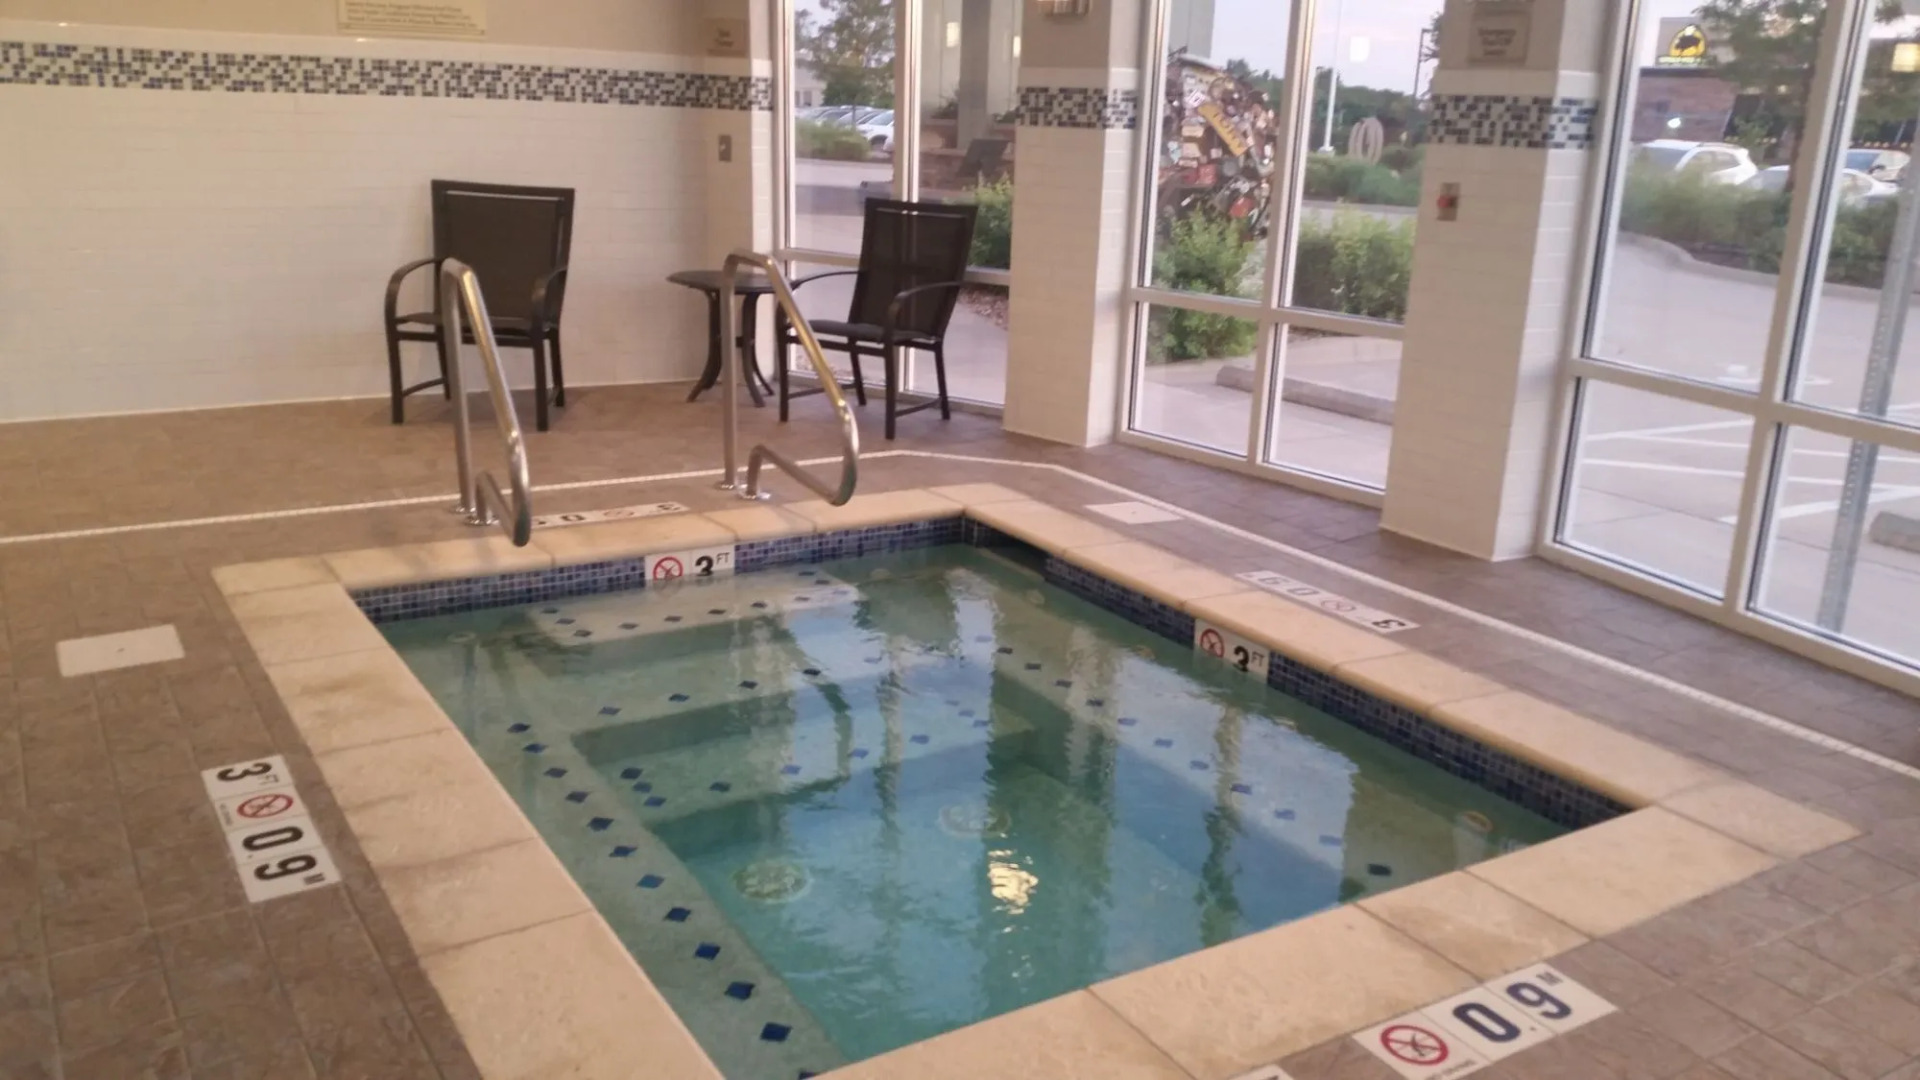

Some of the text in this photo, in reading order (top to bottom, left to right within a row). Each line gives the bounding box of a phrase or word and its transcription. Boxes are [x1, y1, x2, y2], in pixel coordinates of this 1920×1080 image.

[695, 552, 730, 576] 3 FT
[217, 762, 272, 782] 3
